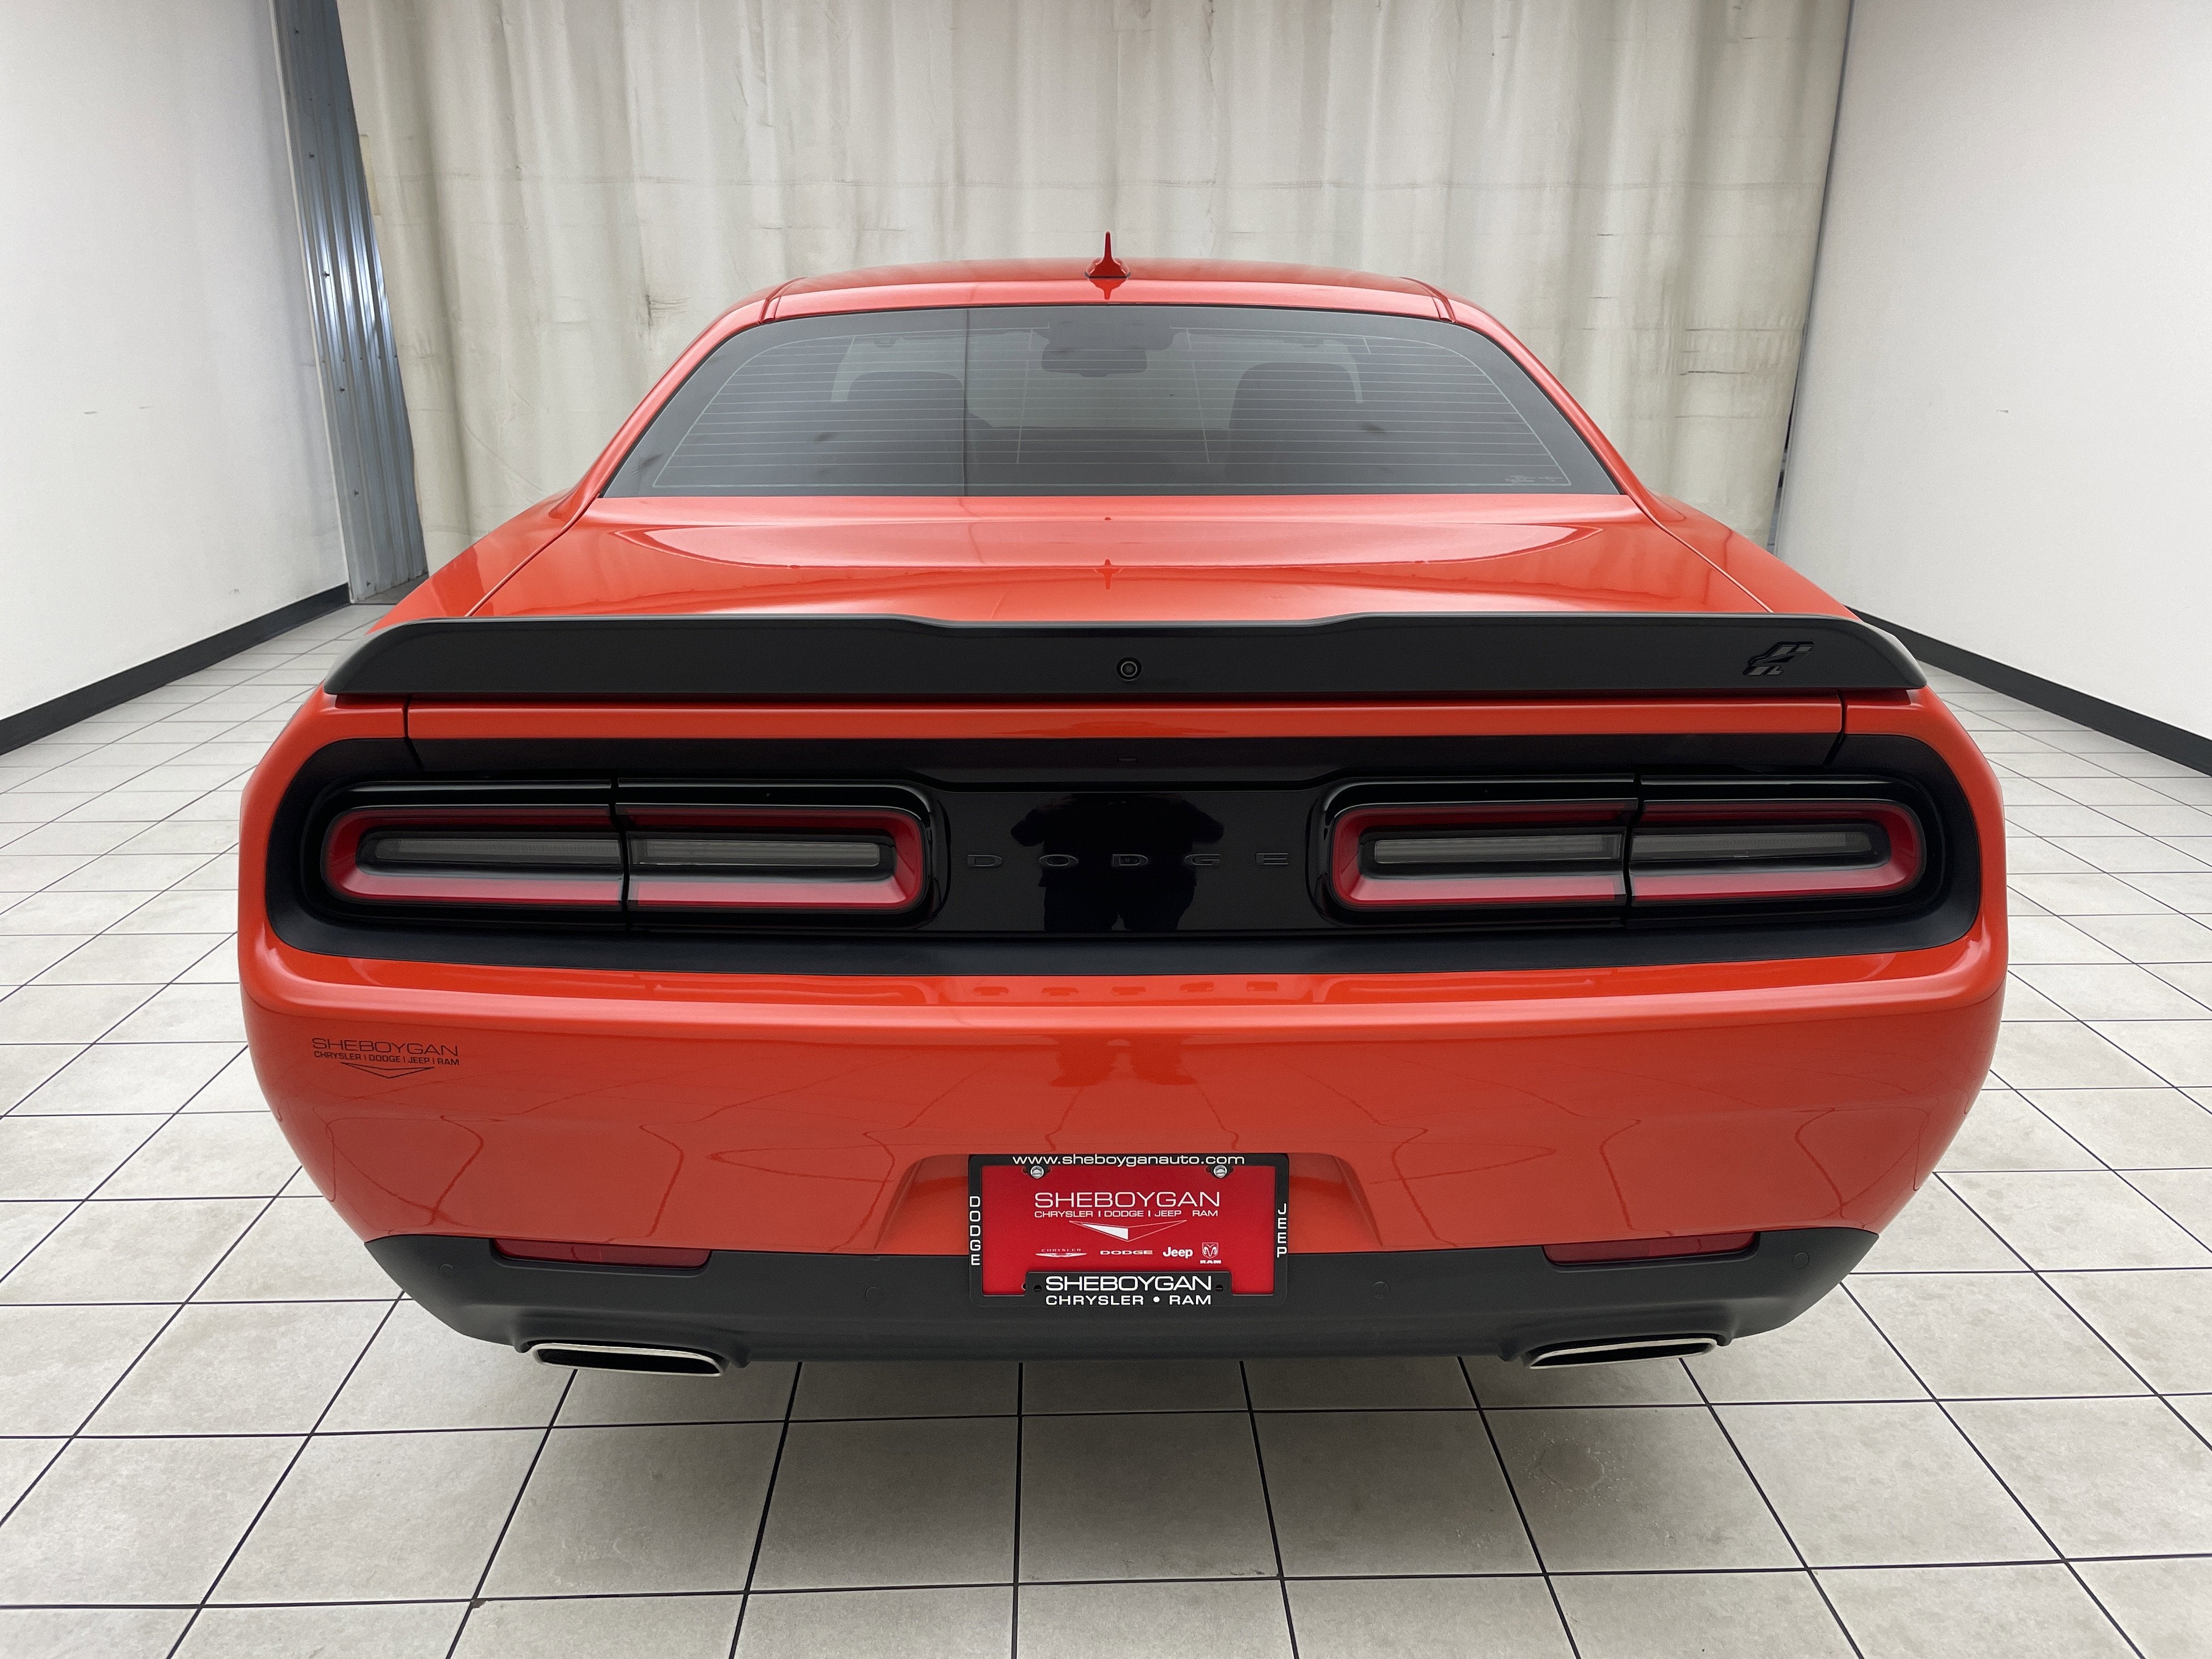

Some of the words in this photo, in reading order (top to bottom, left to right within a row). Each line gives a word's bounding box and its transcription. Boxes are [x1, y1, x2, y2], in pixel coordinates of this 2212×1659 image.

[967, 851, 1289, 868] DODGE
[312, 1037, 459, 1056] SHEBOYGAN
[314, 1051, 362, 1060] CHRYSLER
[369, 1054, 400, 1063] DODGE
[408, 1056, 430, 1064] JEEP
[1012, 1154, 1245, 1167] www.sheboyganauto.com
[1034, 1191, 1221, 1208] SHEBOYGAN
[1034, 1210, 1093, 1218] CHRYSLER
[1154, 1209, 1182, 1217] JEEP
[969, 1195, 981, 1266] DODGE
[1277, 1203, 1287, 1258] JEEP
[1163, 1246, 1193, 1259] Jeep
[1046, 1275, 1212, 1291] SHEBOYGAN
[1046, 1295, 1144, 1306] CHRYSLER
[1169, 1295, 1211, 1306] RAM
